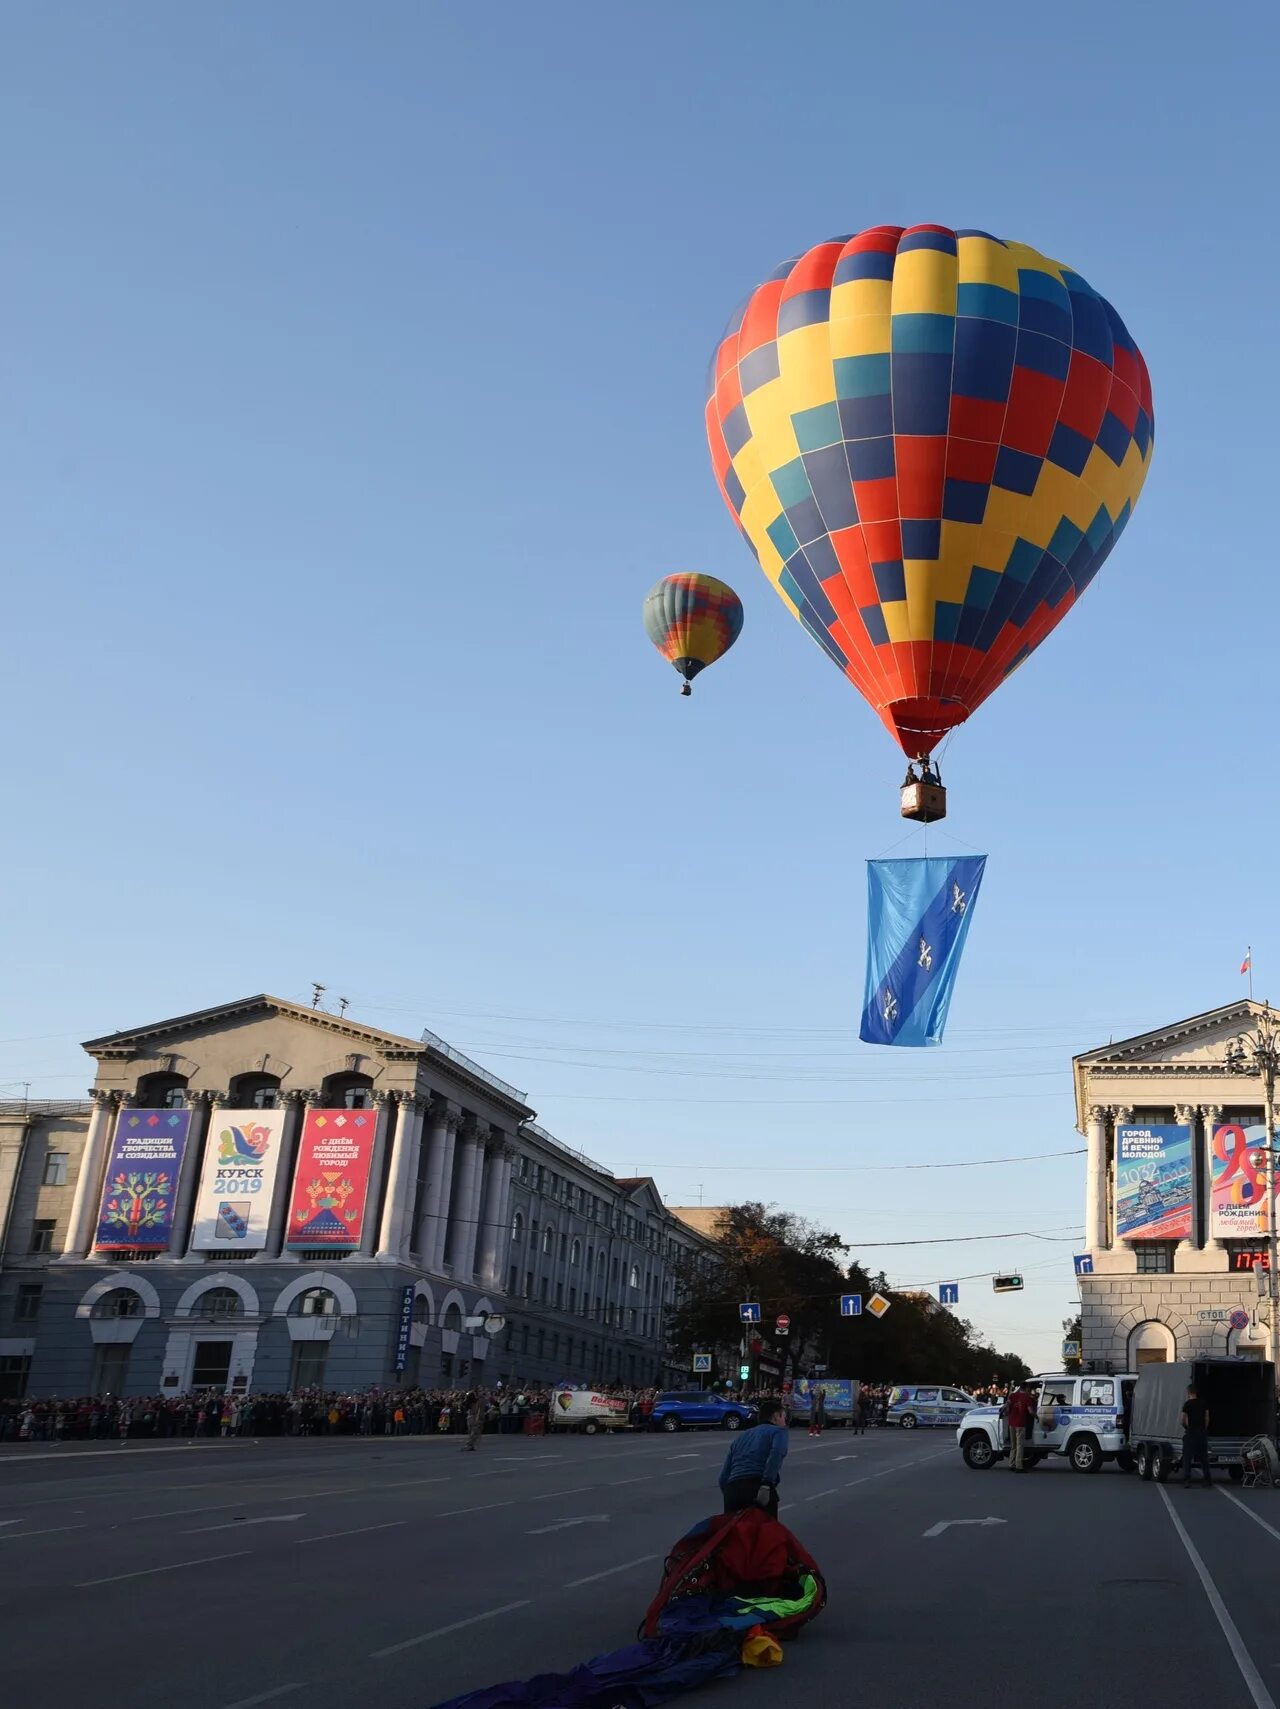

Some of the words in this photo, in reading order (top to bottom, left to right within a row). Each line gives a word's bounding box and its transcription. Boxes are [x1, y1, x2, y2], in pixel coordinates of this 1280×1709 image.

[1122, 1130, 1151, 1138] ГОРОД
[1122, 1136, 1163, 1144] ДРЕВНИЙ
[216, 1169, 264, 1178] КУРСК
[1121, 1161, 1160, 1184] 1032
[213, 1179, 262, 1194] 2019
[1219, 1217, 1255, 1226] любимый
[1200, 1311, 1224, 1319] СТОП
[396, 1288, 412, 1370] ГОСТИНИЦА
